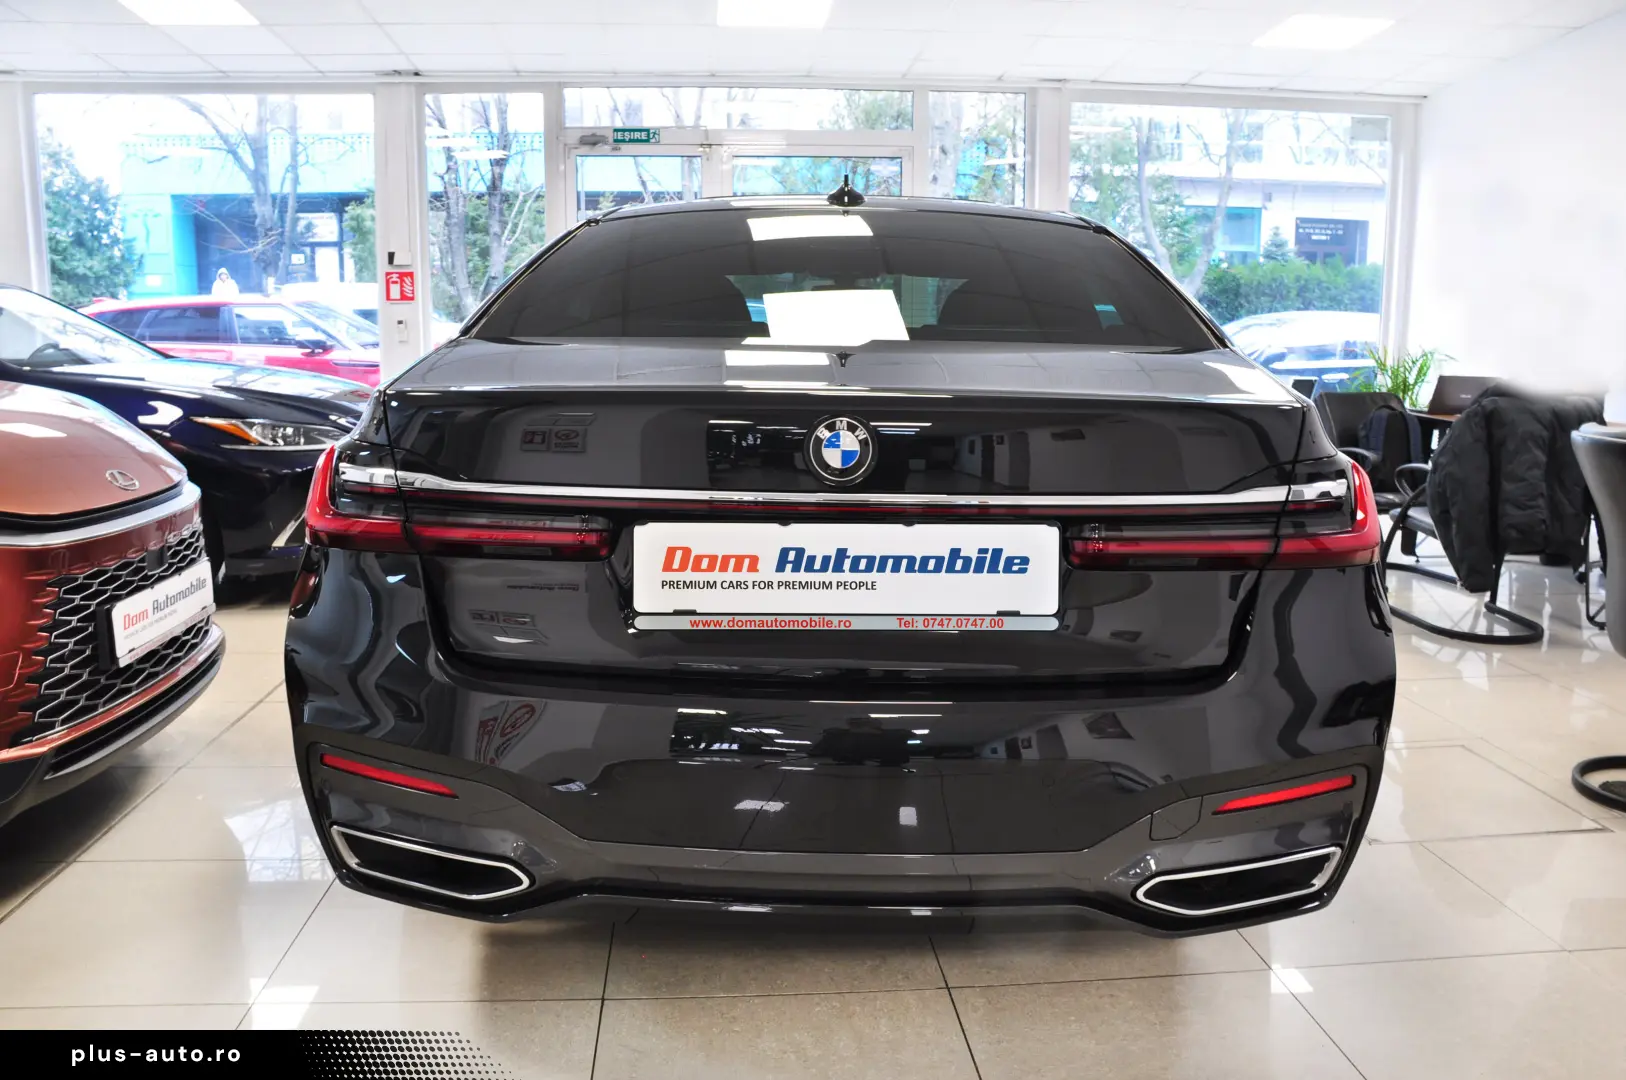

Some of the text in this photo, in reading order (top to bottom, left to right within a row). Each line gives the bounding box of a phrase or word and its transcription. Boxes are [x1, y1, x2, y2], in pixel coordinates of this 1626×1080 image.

[816, 420, 867, 440] BMW
[661, 546, 1030, 574] Dom Automobile
[661, 580, 877, 591] PREMIUM CARS FOR PREMIUM PEOPLE
[123, 608, 149, 631] Dom
[152, 577, 207, 616] Automobile
[689, 617, 852, 629] www.domautomobile.ro
[896, 617, 1005, 629] Tel: 0747.0747.00
